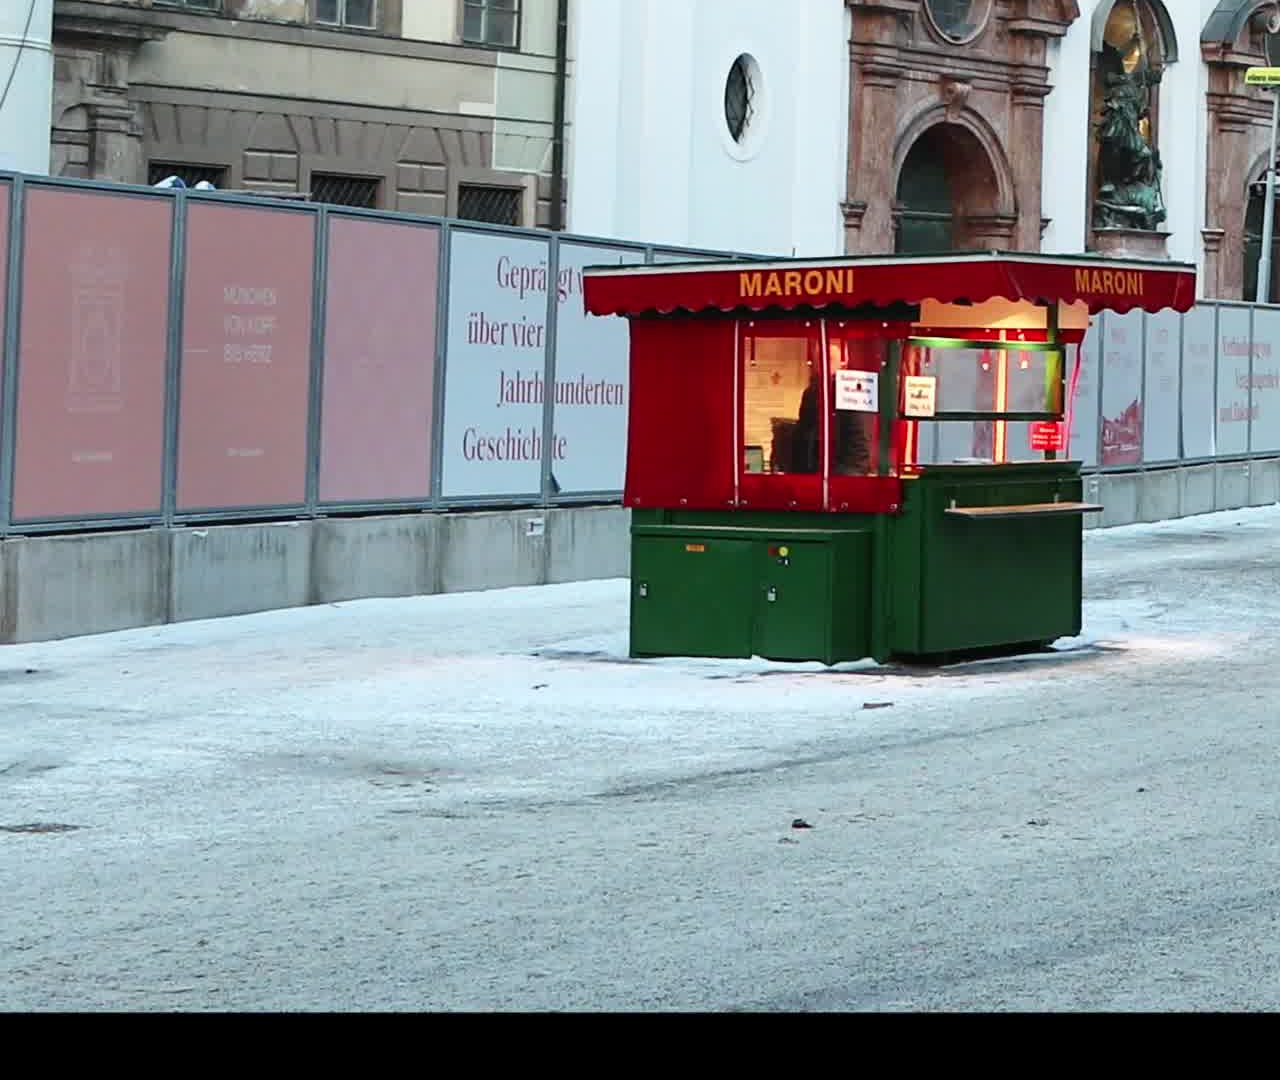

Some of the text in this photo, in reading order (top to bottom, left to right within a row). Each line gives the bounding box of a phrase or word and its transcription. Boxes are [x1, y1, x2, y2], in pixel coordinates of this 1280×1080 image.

[497, 255, 580, 304] Geprägt
[740, 270, 854, 297] MARONI
[1074, 268, 1144, 297] MARONI
[467, 311, 544, 348] über vier
[496, 370, 625, 408] Jahrhunderten
[462, 426, 568, 462] Geschichte
